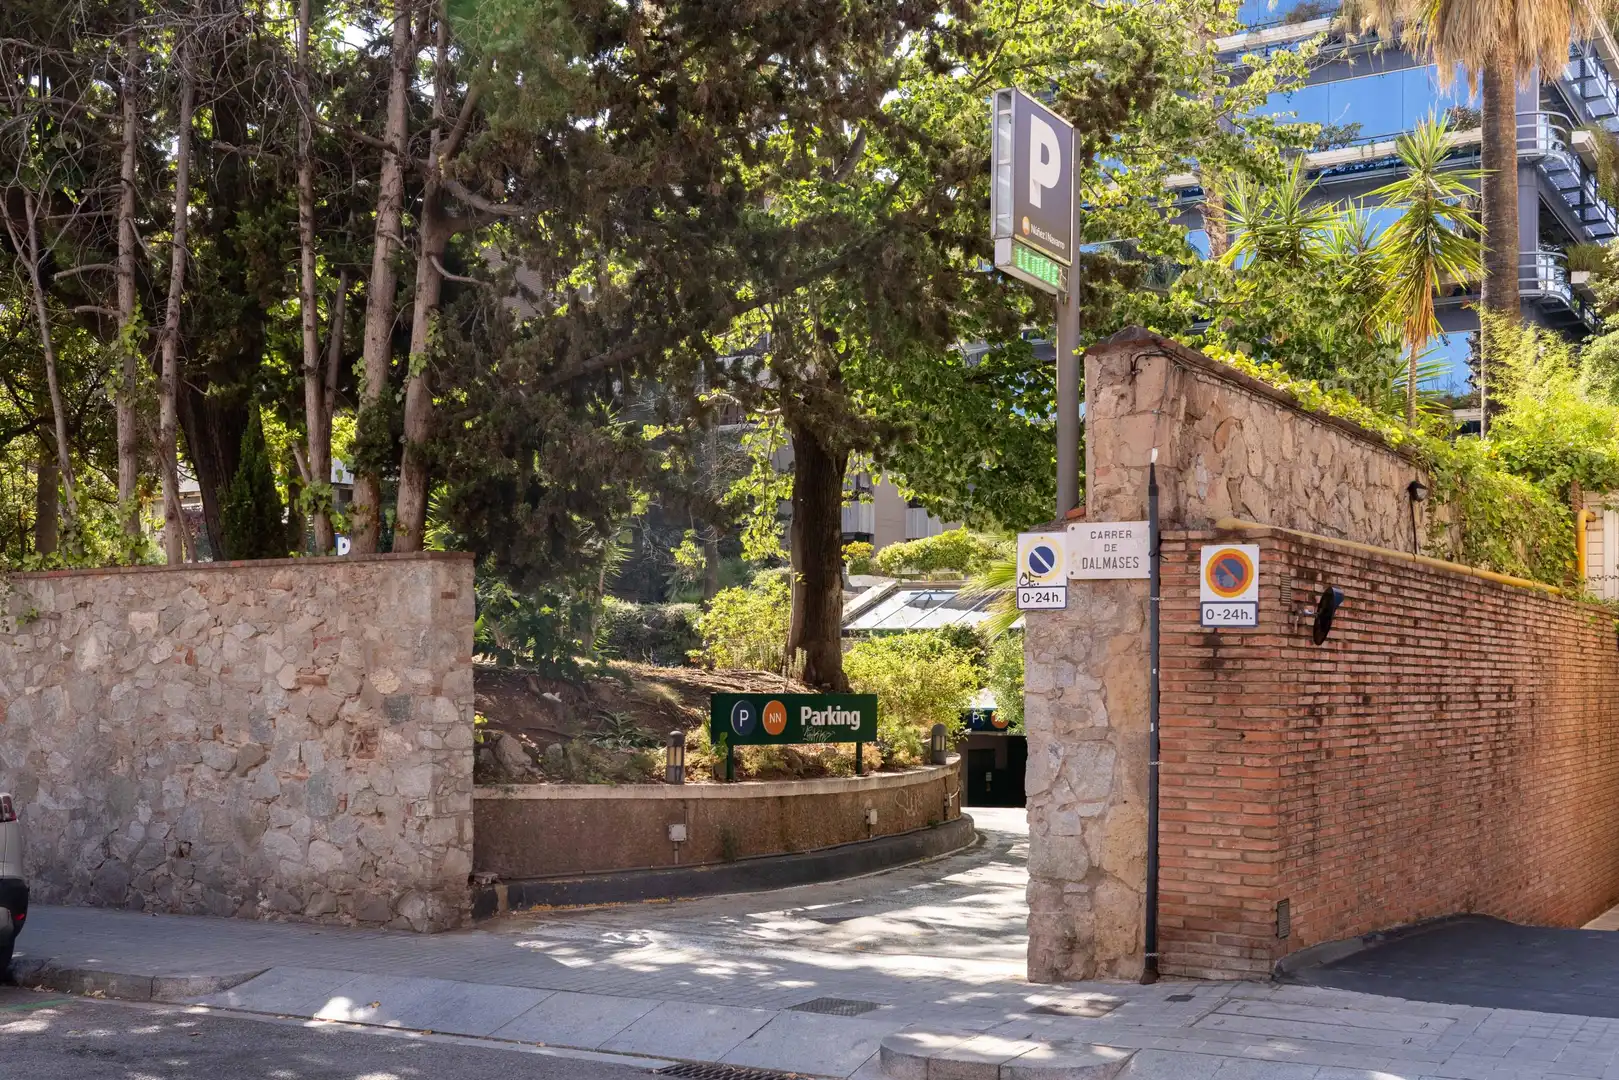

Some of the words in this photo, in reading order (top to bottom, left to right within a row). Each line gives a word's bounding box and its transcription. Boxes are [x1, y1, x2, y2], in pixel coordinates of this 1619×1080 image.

[1029, 113, 1061, 209] P
[1031, 223, 1046, 240] Núñez
[1047, 232, 1066, 250] Navarro
[1090, 530, 1132, 539] CARRER
[1104, 543, 1118, 552] DE
[1082, 556, 1139, 570] DALMASES
[739, 709, 749, 727] P
[769, 712, 782, 724] NN
[800, 705, 860, 731] Parking
[972, 711, 980, 723] P
